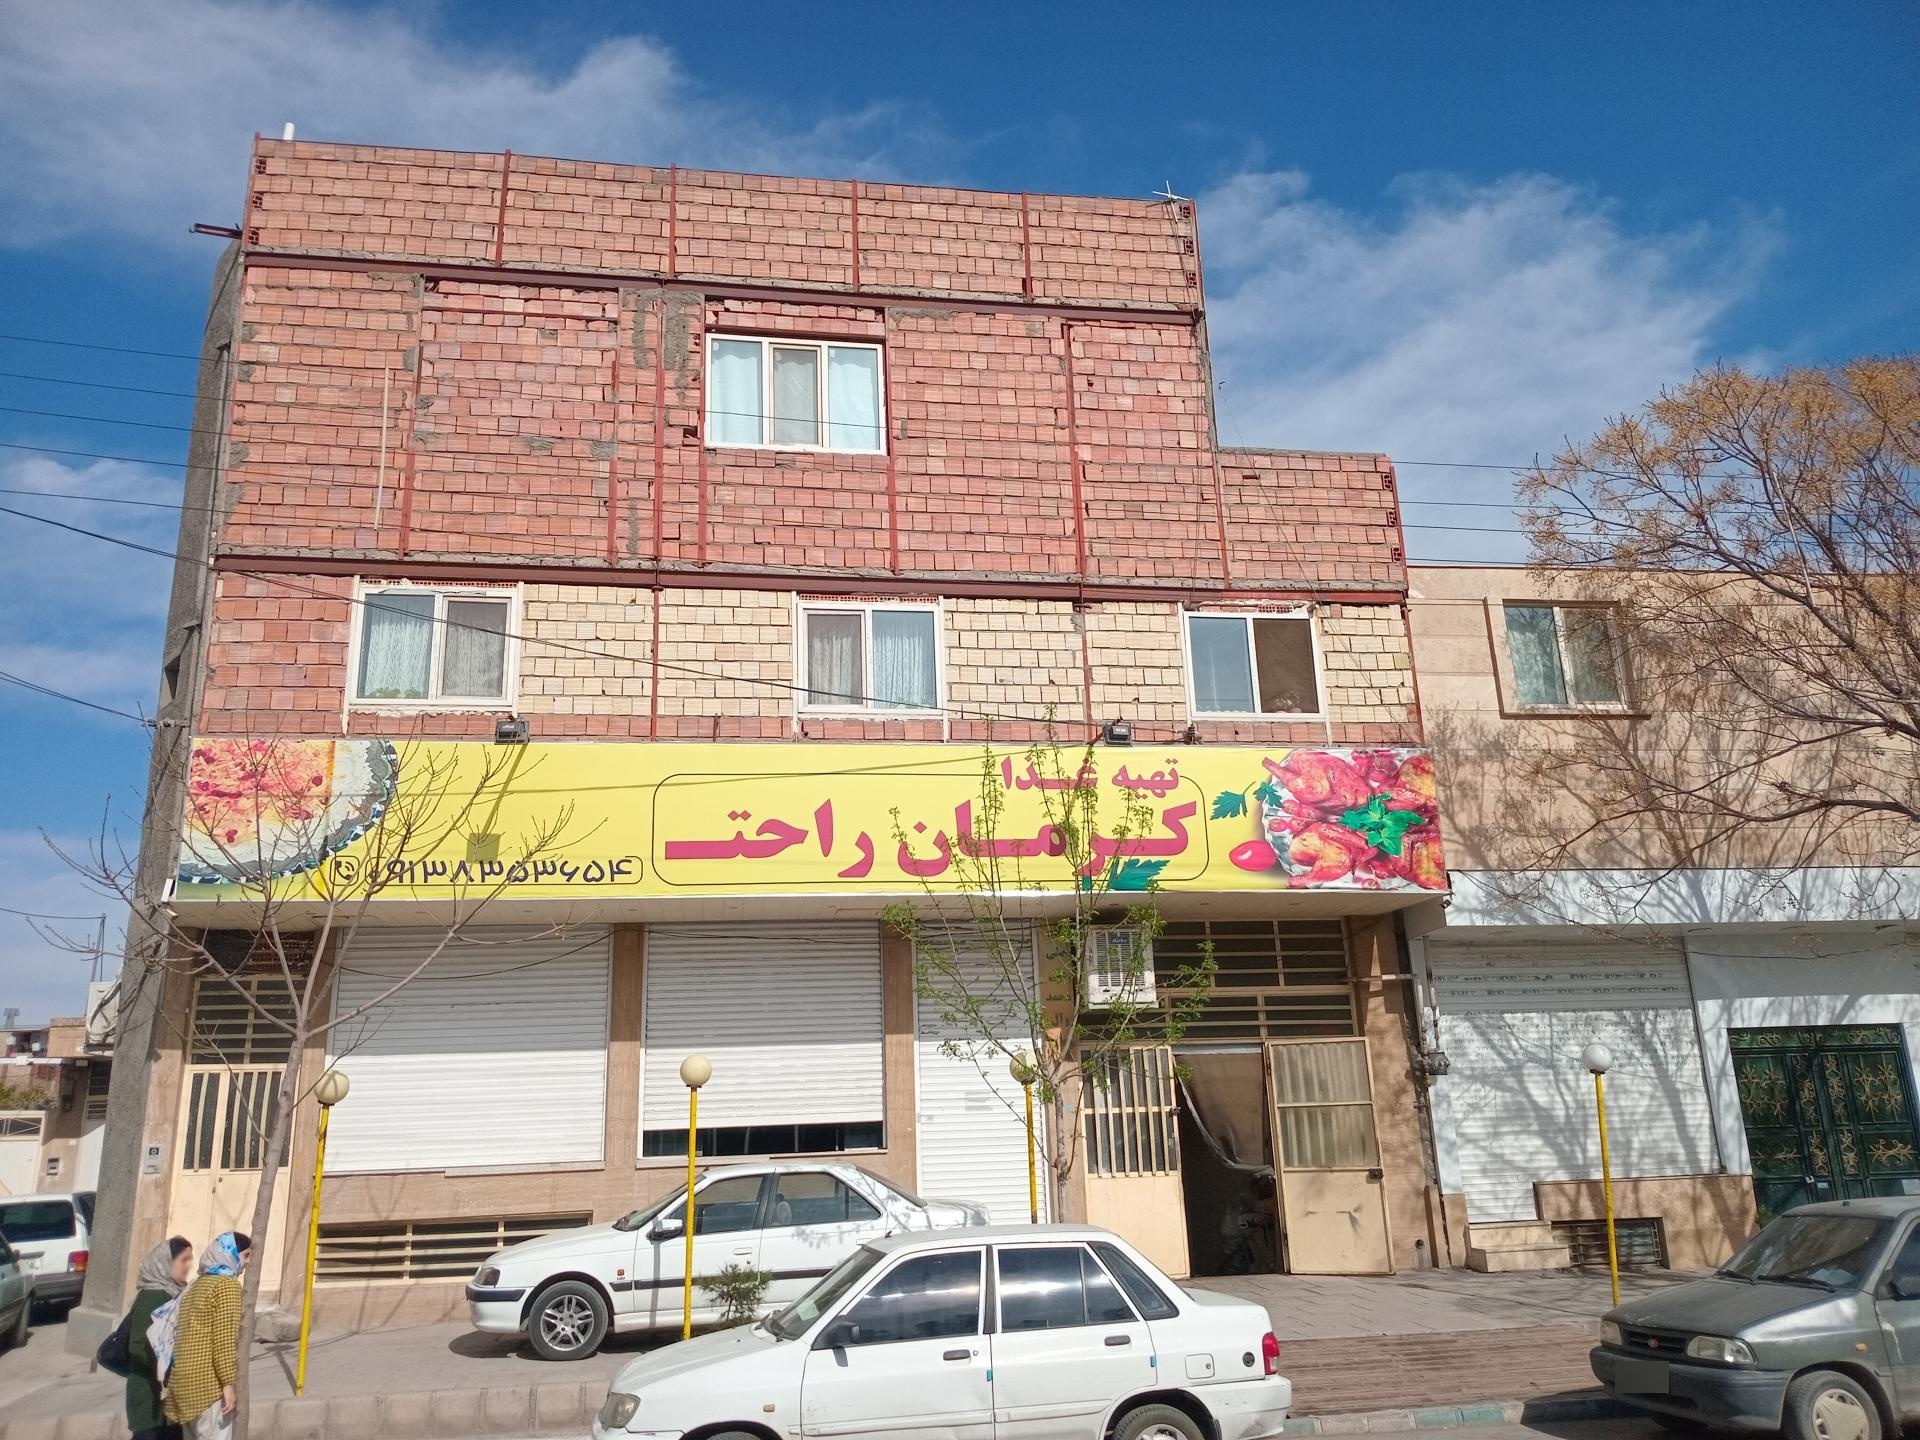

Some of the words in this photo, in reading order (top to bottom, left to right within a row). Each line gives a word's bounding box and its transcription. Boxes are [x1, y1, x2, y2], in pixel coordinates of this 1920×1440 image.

[1000, 754, 1098, 790] غذا
[1111, 757, 1179, 799] تهیه
[897, 799, 1197, 877] کرمان
